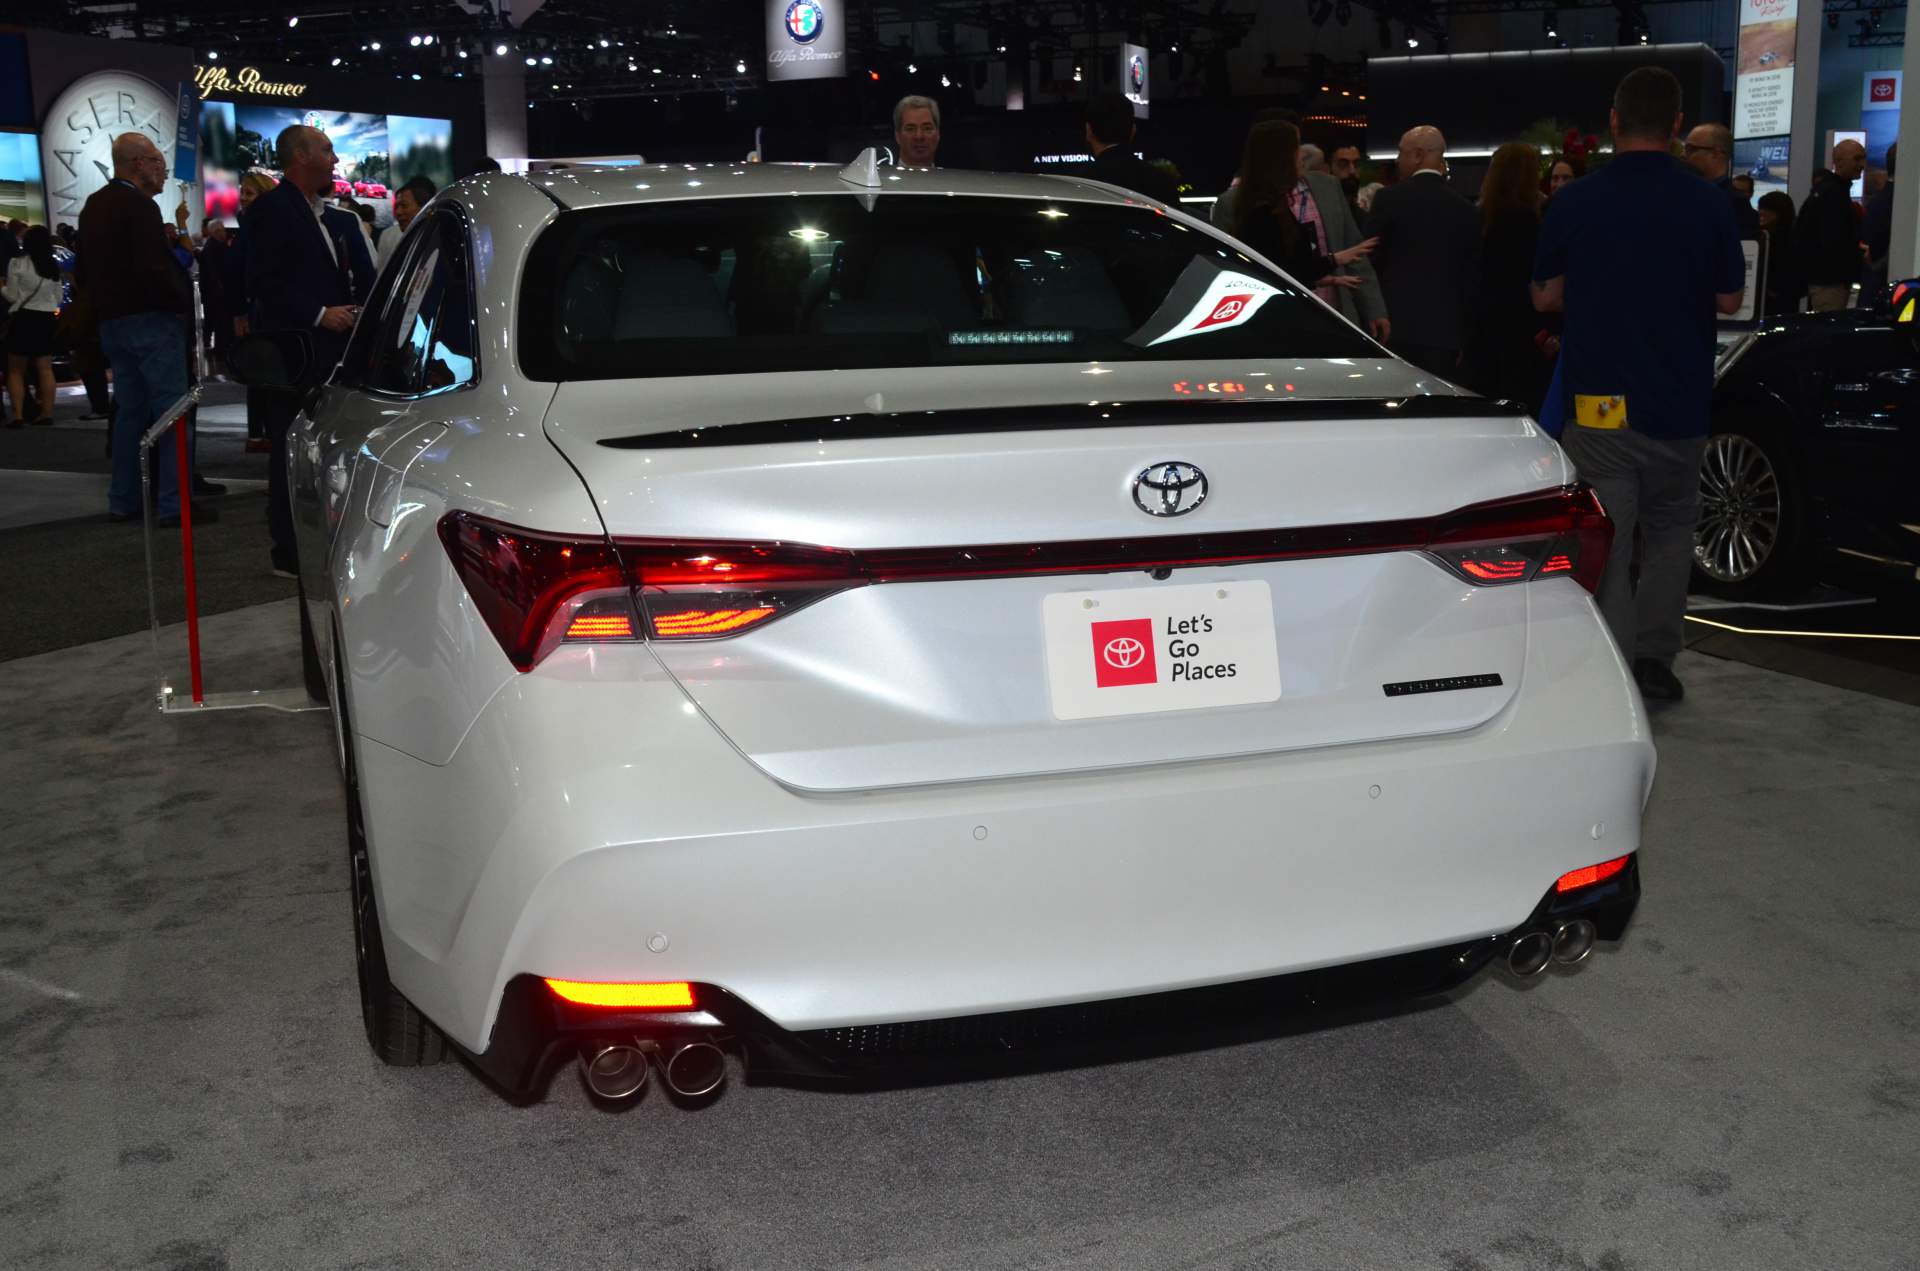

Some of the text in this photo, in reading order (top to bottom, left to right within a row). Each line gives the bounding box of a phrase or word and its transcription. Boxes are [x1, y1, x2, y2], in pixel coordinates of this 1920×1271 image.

[769, 46, 843, 68] Alfa Romeo
[231, 66, 307, 97] Romeo
[51, 90, 177, 217] MASERA
[1041, 155, 1059, 163] NEW
[1060, 154, 1089, 162] VISION
[1167, 614, 1213, 635] Let's
[1169, 639, 1199, 658] Go
[1171, 662, 1237, 682] Places
